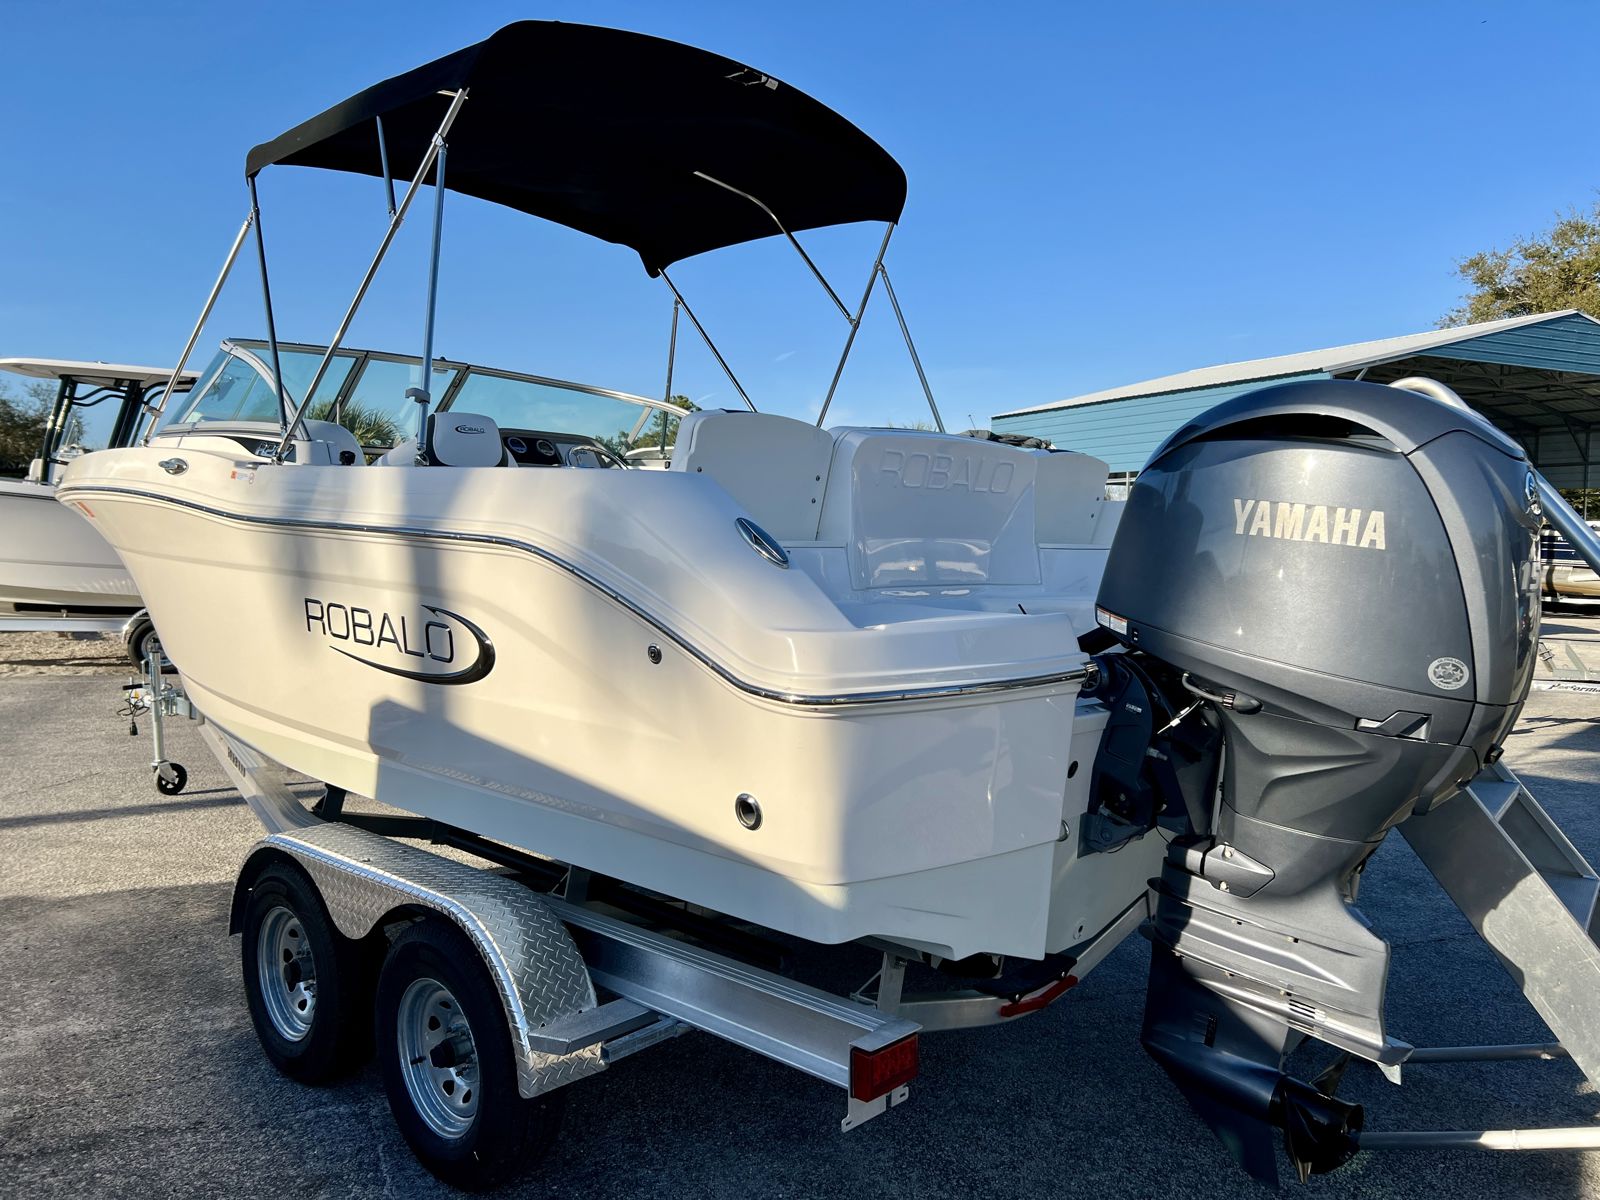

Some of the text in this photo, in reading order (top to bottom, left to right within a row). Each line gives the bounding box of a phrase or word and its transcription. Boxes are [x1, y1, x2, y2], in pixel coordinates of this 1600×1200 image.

[877, 448, 1016, 494] ROBALO
[1234, 499, 1385, 550] YAMAHA
[305, 598, 454, 663] ROBALO
